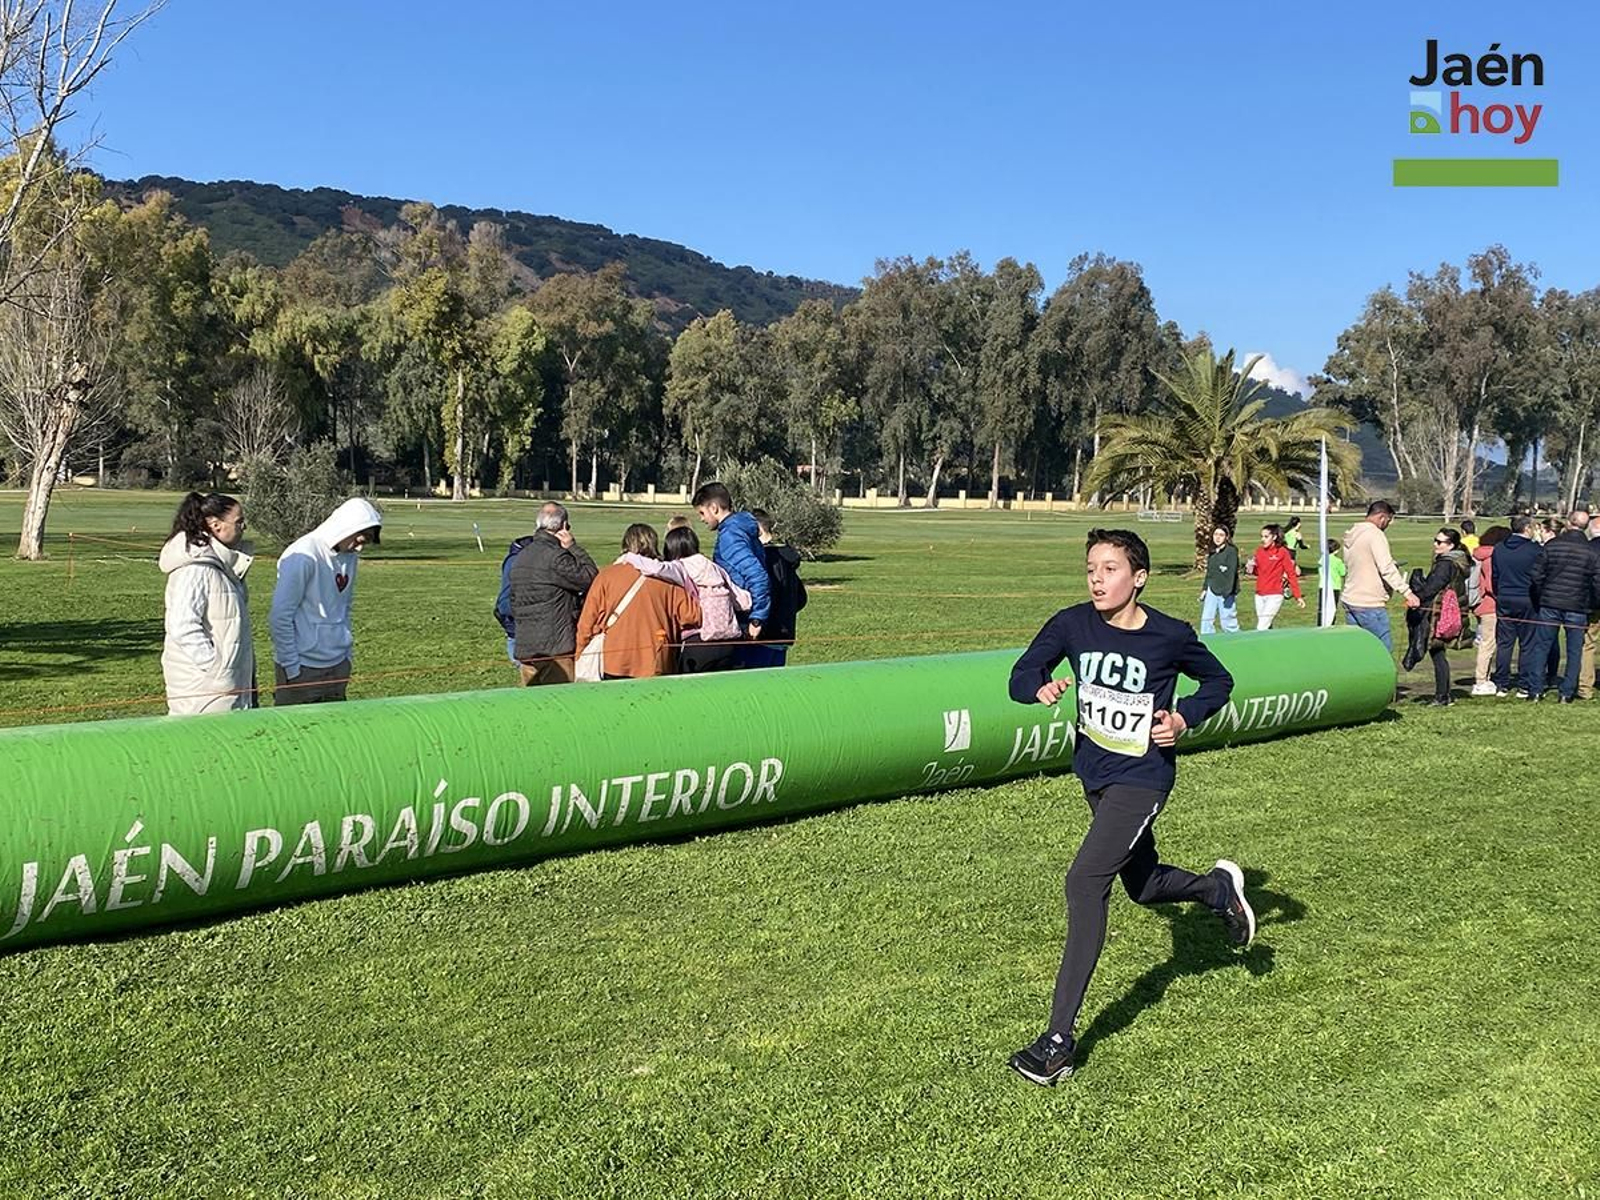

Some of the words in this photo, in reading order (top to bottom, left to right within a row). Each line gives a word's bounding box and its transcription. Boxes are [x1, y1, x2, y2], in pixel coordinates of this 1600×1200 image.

[1079, 651, 1147, 692] UCB
[1084, 701, 1146, 733] 1107
[1211, 688, 1329, 735] INTERIOR
[918, 756, 975, 787] Jaén
[0, 820, 217, 940] JAÉN
[235, 778, 531, 889] PARAÍSO
[542, 757, 784, 838] INTERIOR
